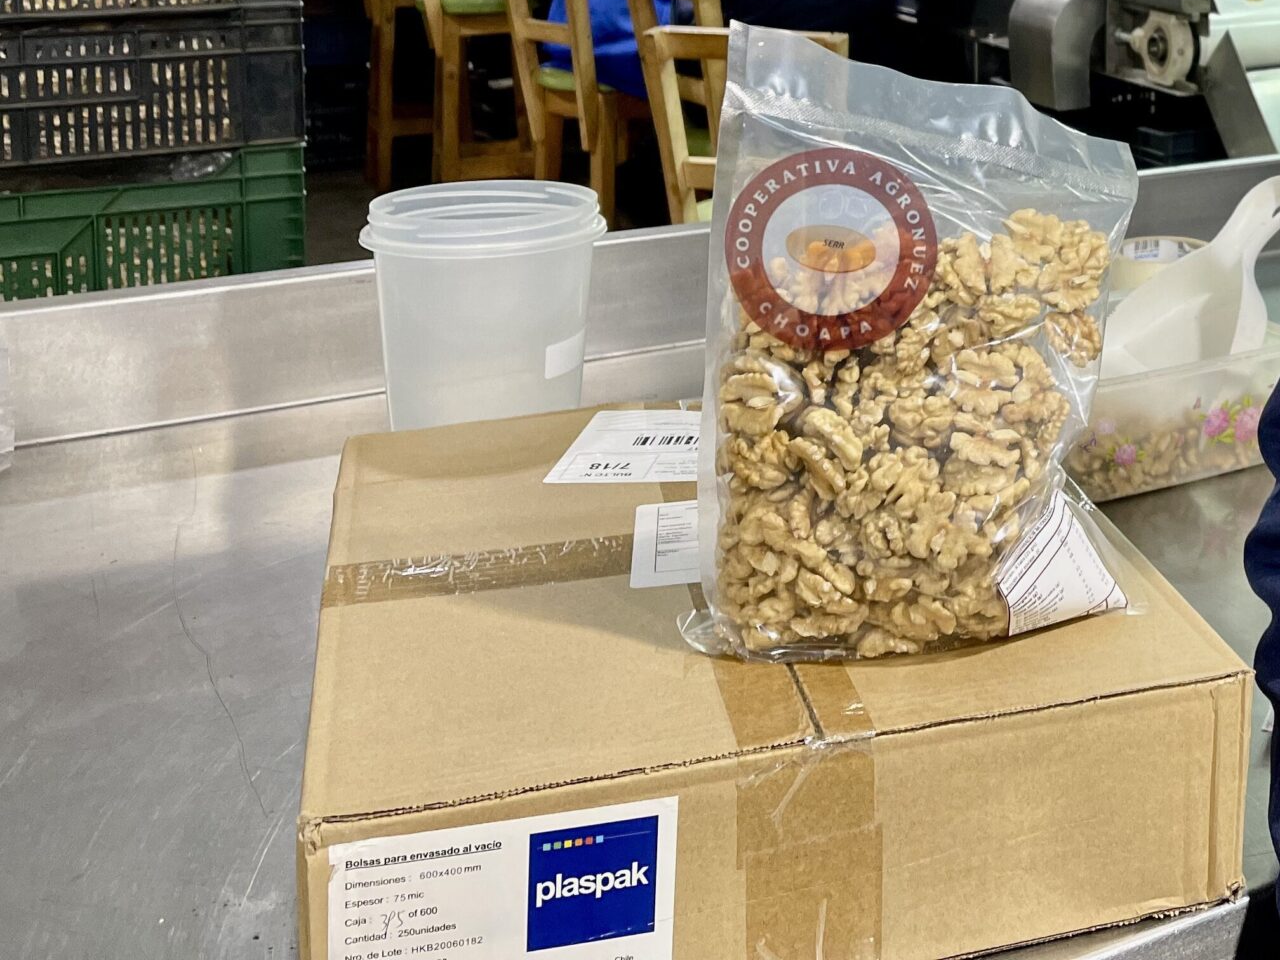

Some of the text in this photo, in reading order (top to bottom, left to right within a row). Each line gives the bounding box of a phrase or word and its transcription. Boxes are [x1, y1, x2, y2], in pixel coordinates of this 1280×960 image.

[736, 159, 926, 291] COOPERATIVA AGRONUEZ
[759, 302, 873, 341] CHOAPA
[588, 462, 632, 470] 7/18
[345, 859, 381, 869] Bolsas
[384, 855, 408, 866] para
[410, 846, 461, 860] envasado
[462, 843, 472, 853] al
[345, 876, 406, 890] Dimensiones
[419, 866, 463, 880] 600x400
[464, 864, 482, 873] mm
[535, 861, 649, 908] plaspak
[345, 897, 384, 909] Espesor
[394, 893, 406, 903] 75
[407, 891, 425, 901] mic
[345, 917, 367, 928] Caja
[408, 908, 418, 918] of
[420, 906, 438, 917] 600
[345, 931, 387, 945] Cantidad
[367, 951, 379, 960] de
[381, 949, 402, 958] Lote
[411, 936, 484, 954] HKB20060182
